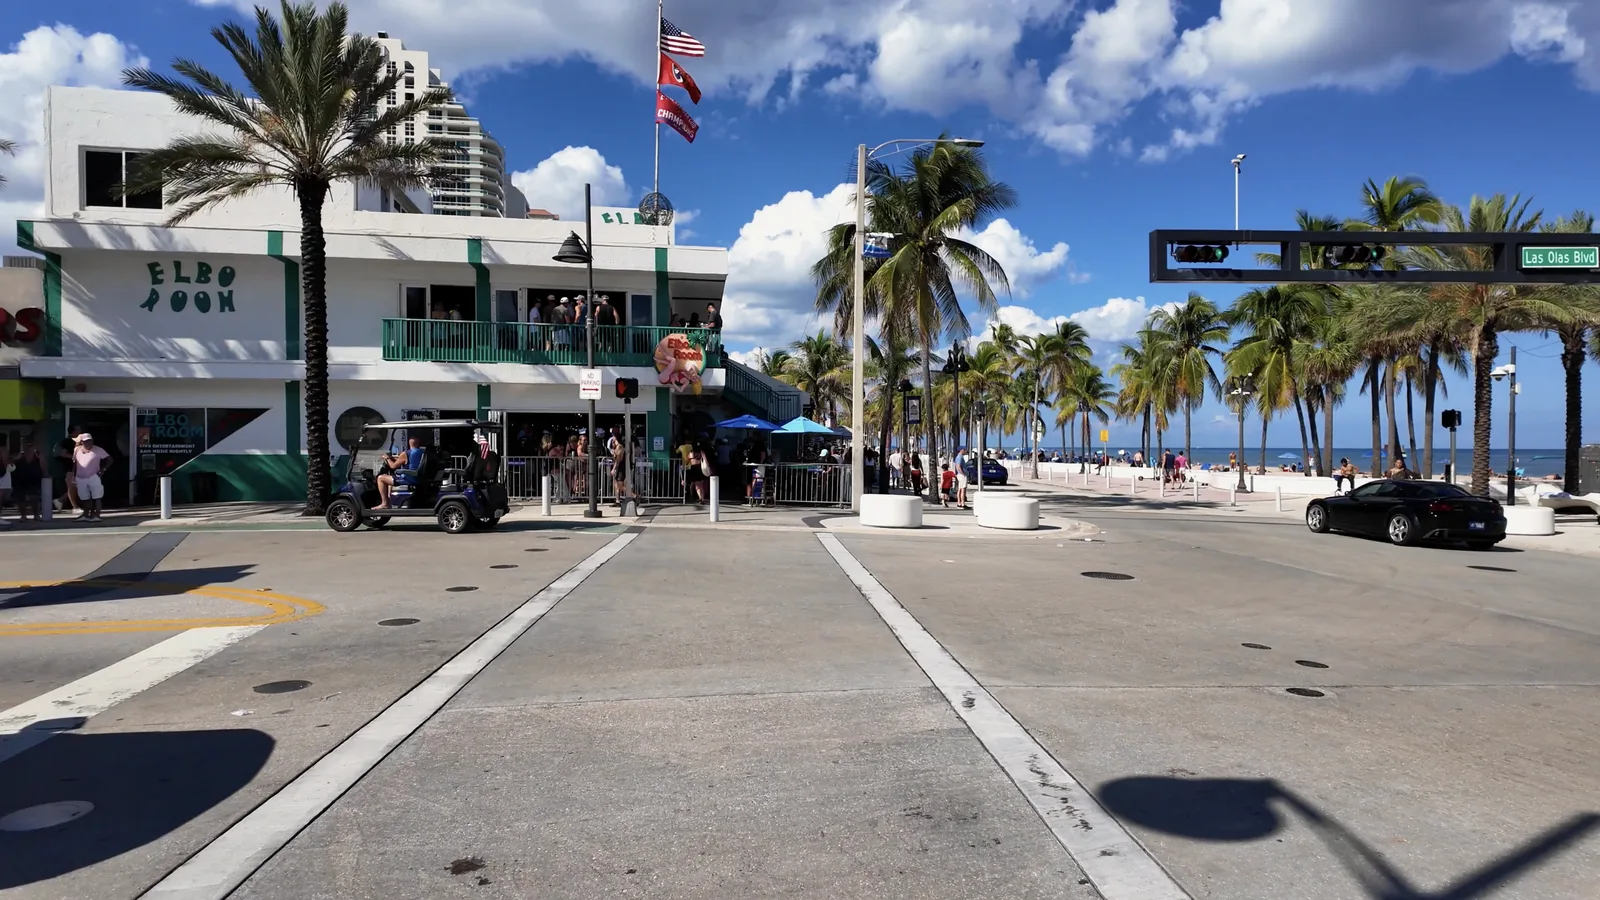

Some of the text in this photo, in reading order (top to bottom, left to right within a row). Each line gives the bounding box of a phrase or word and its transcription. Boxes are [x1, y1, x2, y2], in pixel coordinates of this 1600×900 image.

[657, 108, 694, 138] CHAMPONS
[1525, 250, 1595, 264] Las Olas Blvd
[146, 260, 236, 288] ELBO
[140, 288, 236, 314] ROOM
[667, 338, 690, 350] Elbo
[673, 349, 703, 361] Room
[587, 372, 595, 380] NO
[580, 379, 601, 387] PARKING
[144, 415, 189, 425] ELBO
[156, 426, 204, 437] ROOM
